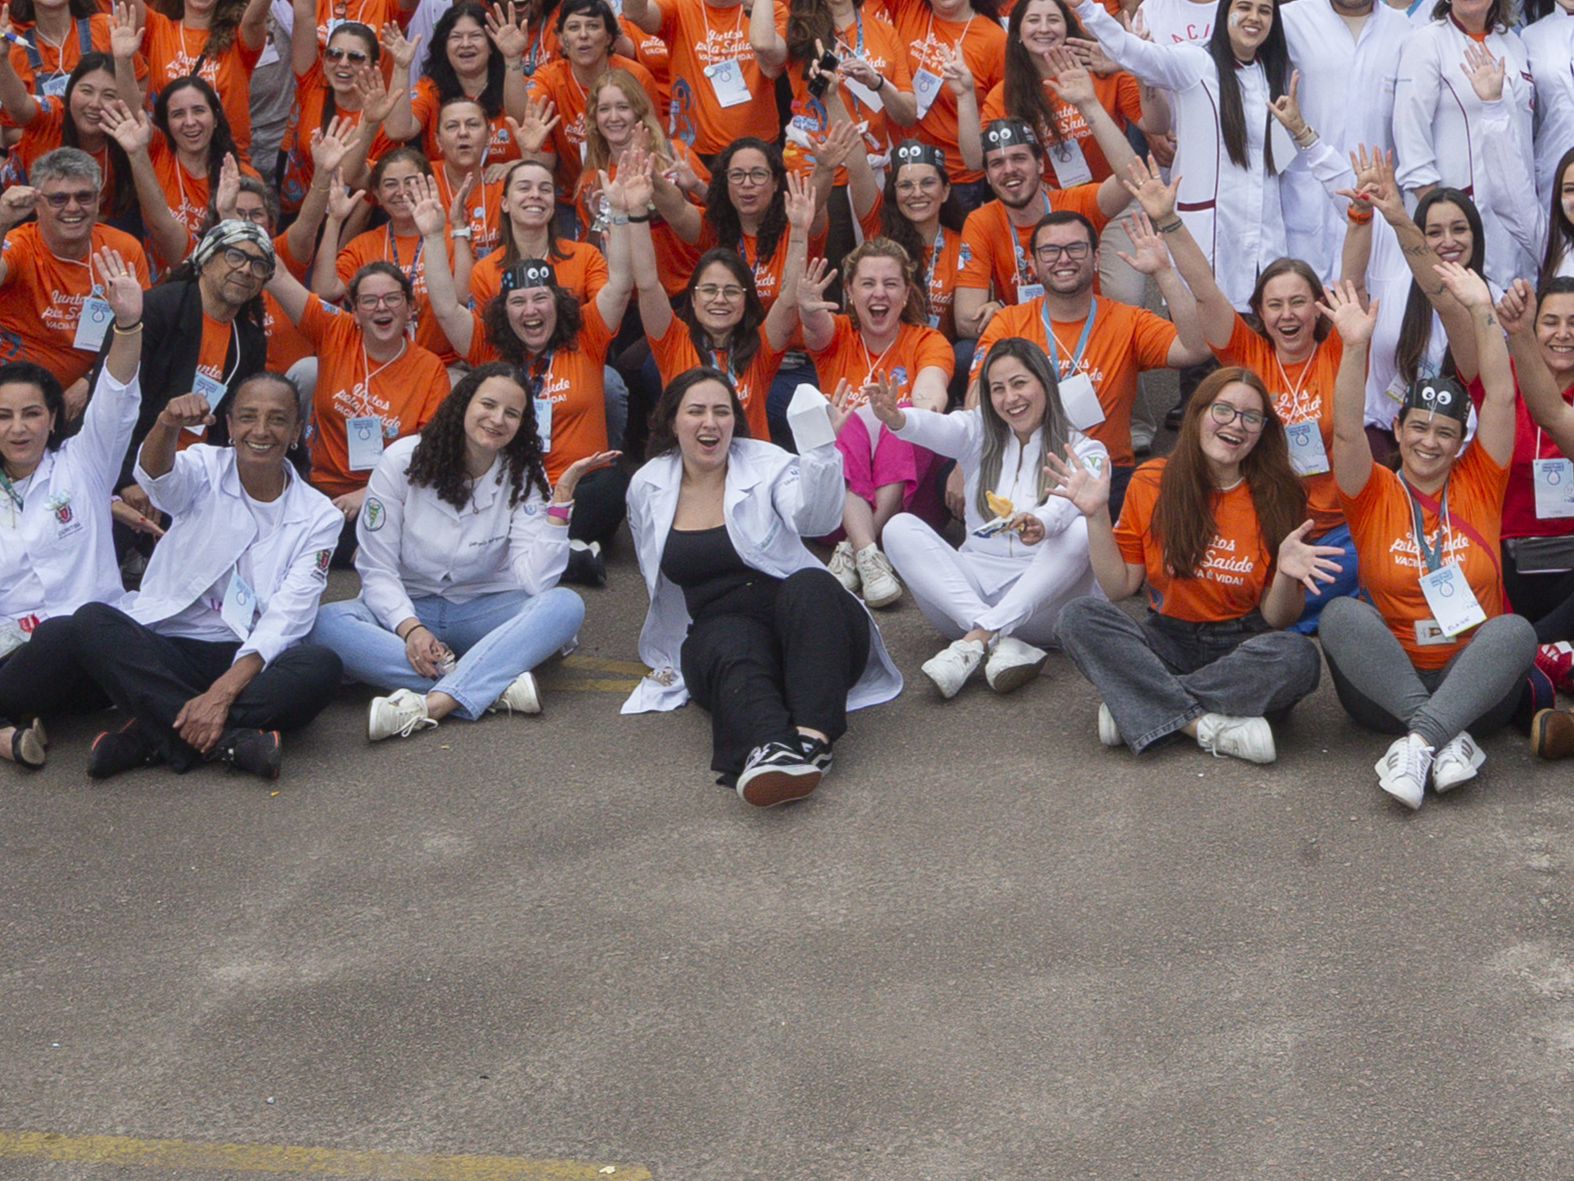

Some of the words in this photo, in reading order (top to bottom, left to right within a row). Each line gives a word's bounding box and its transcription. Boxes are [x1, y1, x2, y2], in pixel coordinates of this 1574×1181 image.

[52, 288, 85, 305] Junto
[1203, 550, 1254, 573] Saúde
[1215, 571, 1244, 585] VIDA!
